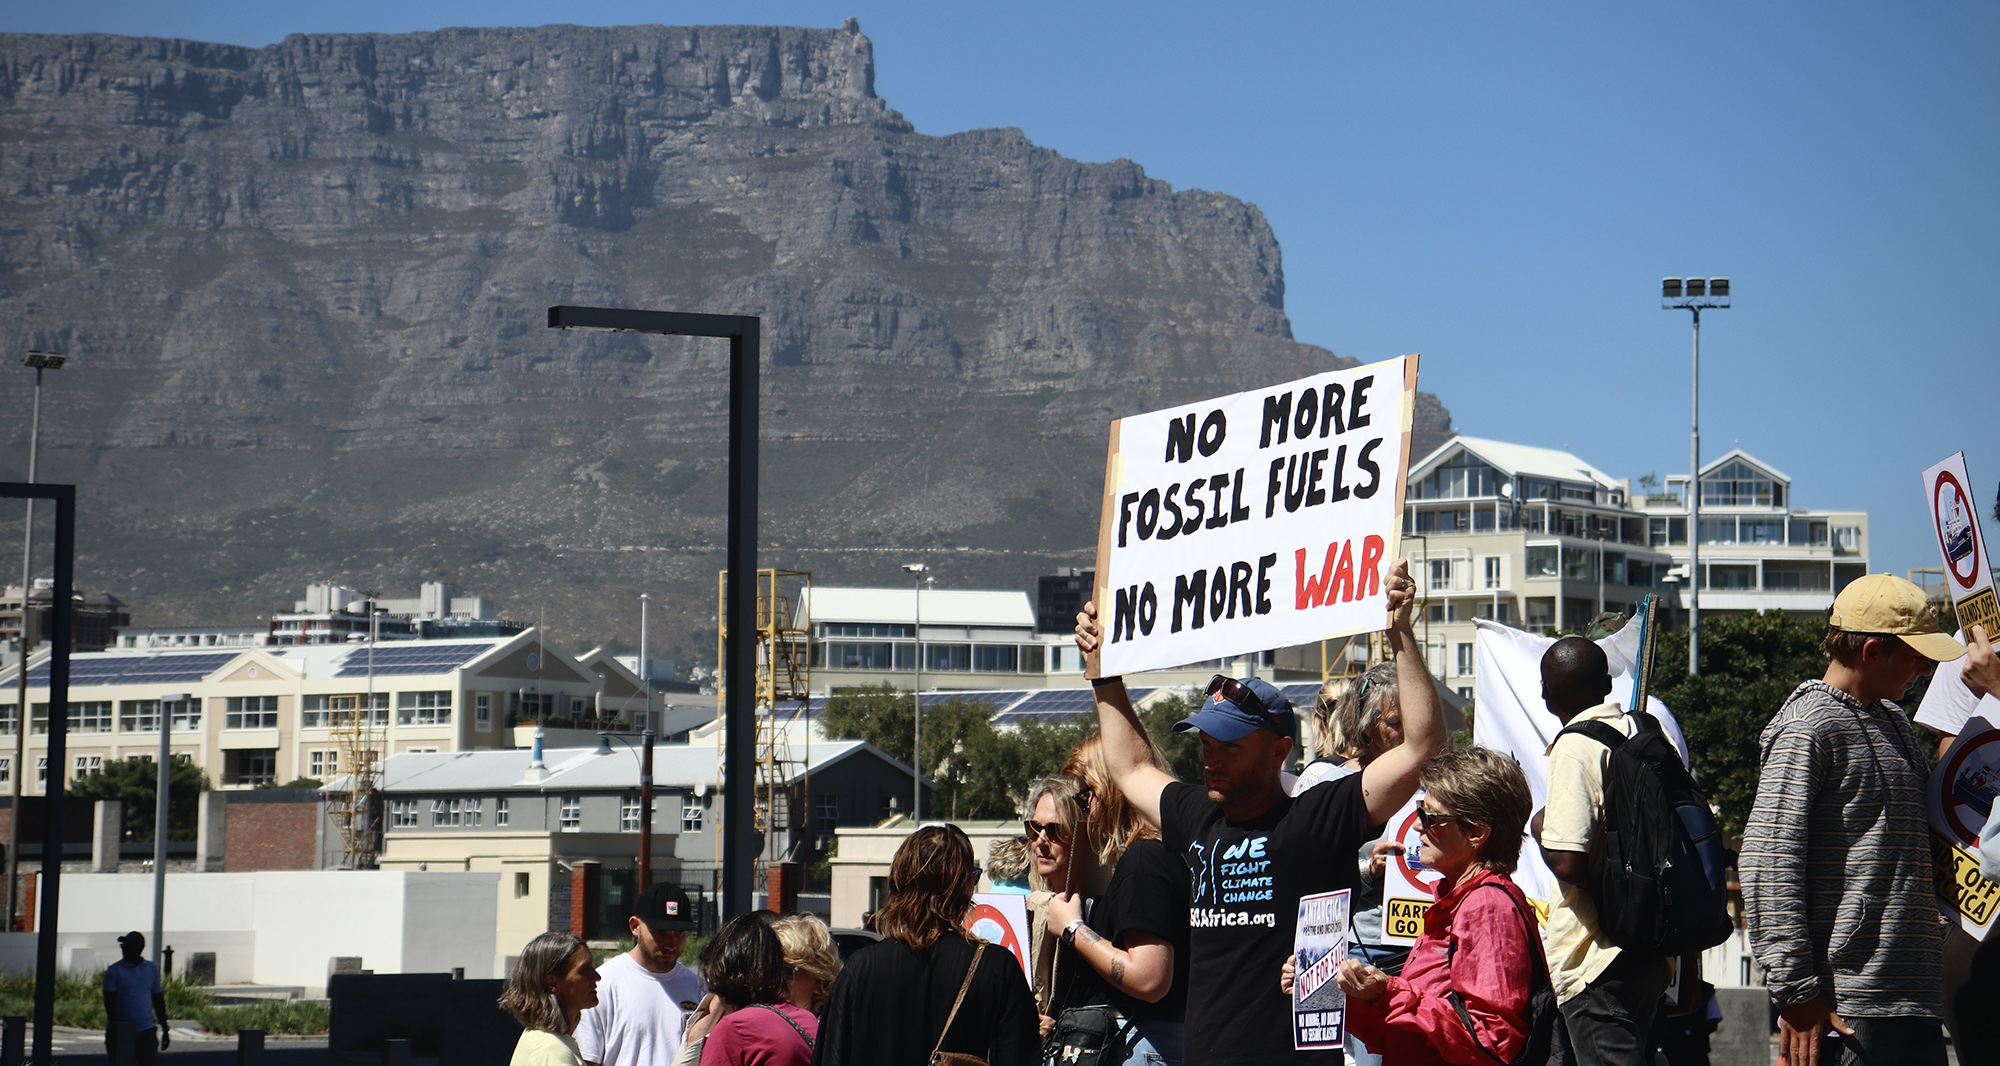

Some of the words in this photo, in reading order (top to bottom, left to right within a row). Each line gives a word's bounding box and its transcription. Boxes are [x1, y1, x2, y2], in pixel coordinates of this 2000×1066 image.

[1165, 409, 1227, 463] NO
[1259, 375, 1374, 449] MORE
[1117, 467, 1250, 548] FOSSIL
[1265, 437, 1383, 518] FUELS
[1111, 581, 1157, 644] NO
[1170, 552, 1277, 634] MORE
[1295, 534, 1385, 611] WAR
[1958, 600, 1982, 627] HANDS
[1981, 594, 1995, 617] OFF
[1222, 836, 1268, 860] WE
[1220, 860, 1271, 876] FIGHT
[1222, 877, 1273, 889] CLIMATE
[1223, 890, 1273, 903] CHANGE
[1964, 867, 2000, 900] OFF
[1303, 898, 1342, 926] ANTARCTICA
[1395, 919, 1418, 935] GO
[1300, 969, 1314, 999] NOT
[1316, 958, 1329, 986] FOR
[1331, 943, 1344, 973] SALE
